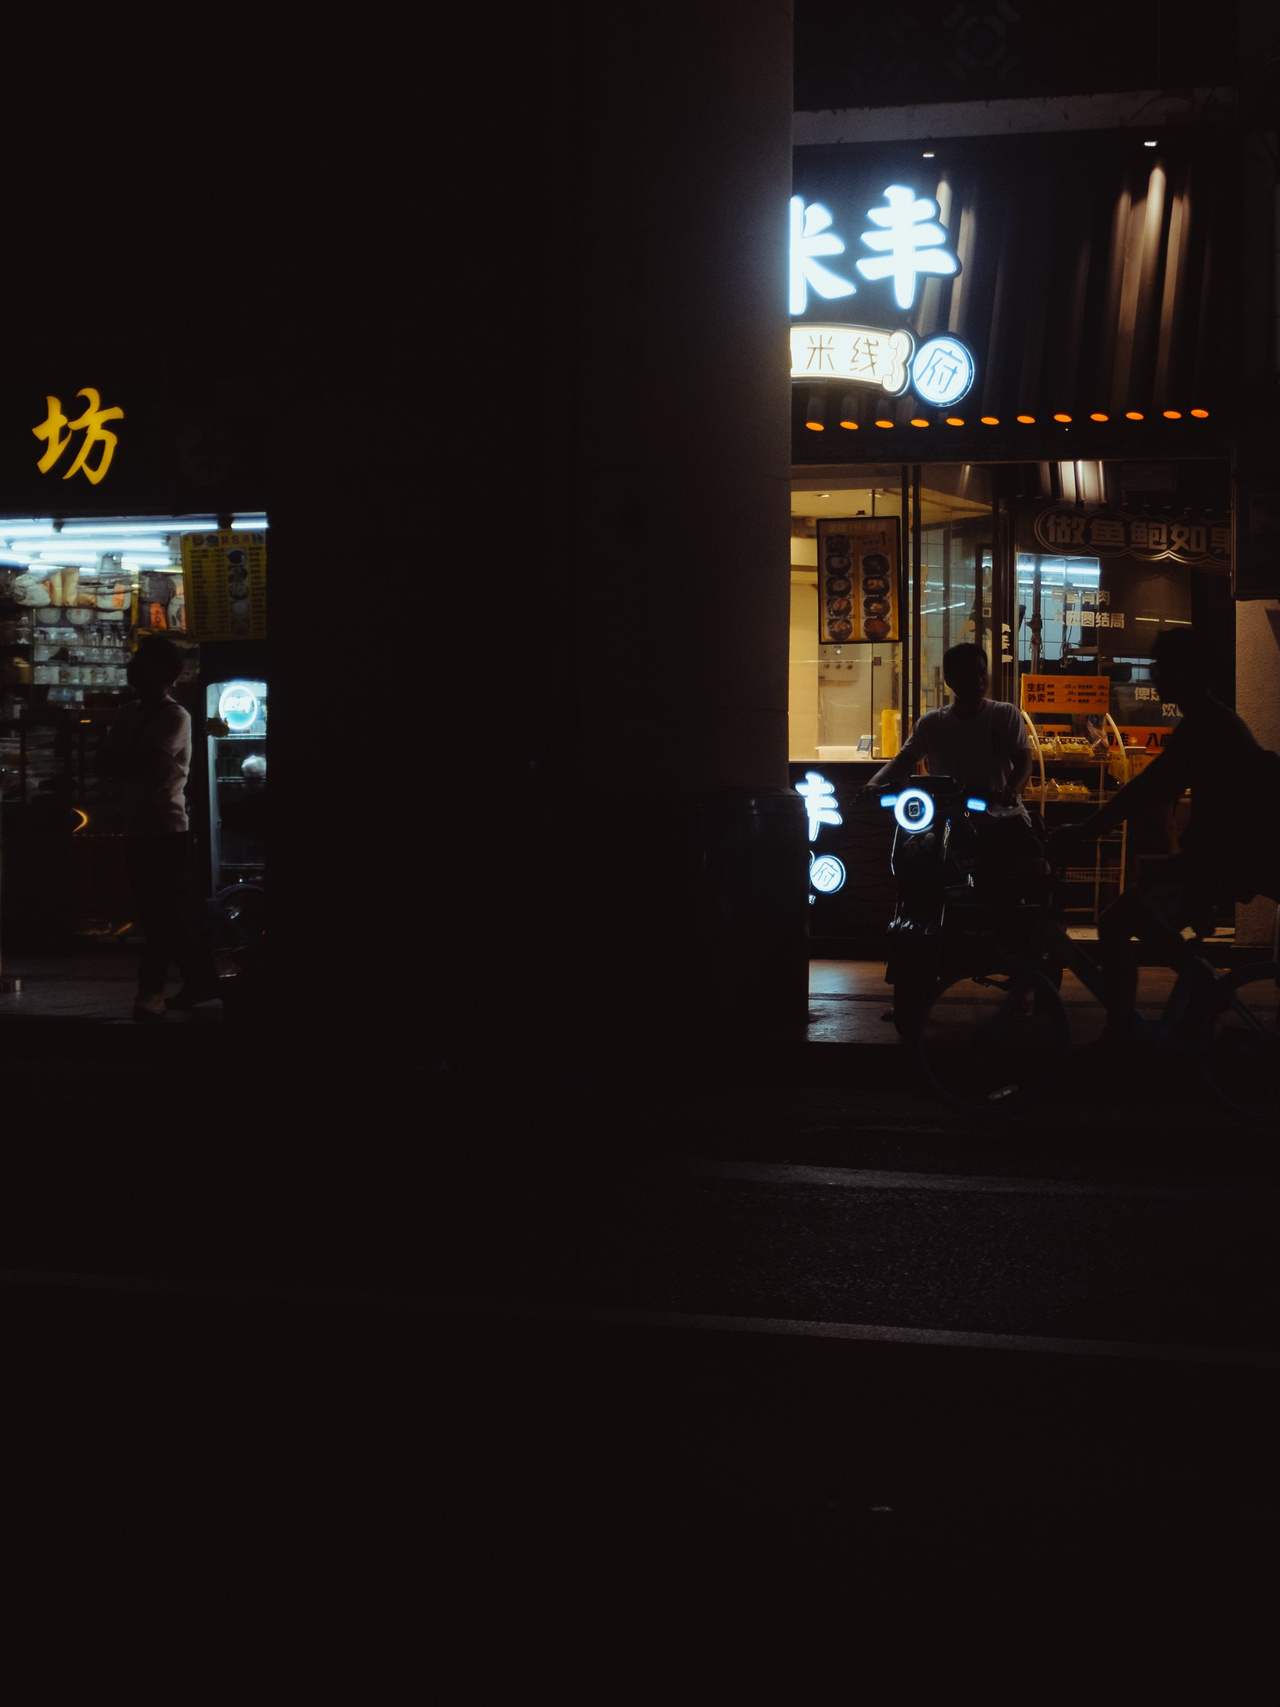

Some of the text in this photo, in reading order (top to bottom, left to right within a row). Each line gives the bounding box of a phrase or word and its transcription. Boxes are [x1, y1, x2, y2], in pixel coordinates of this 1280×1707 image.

[806, 334, 880, 377] 米线
[916, 347, 964, 394] 府
[31, 387, 125, 486] 坊
